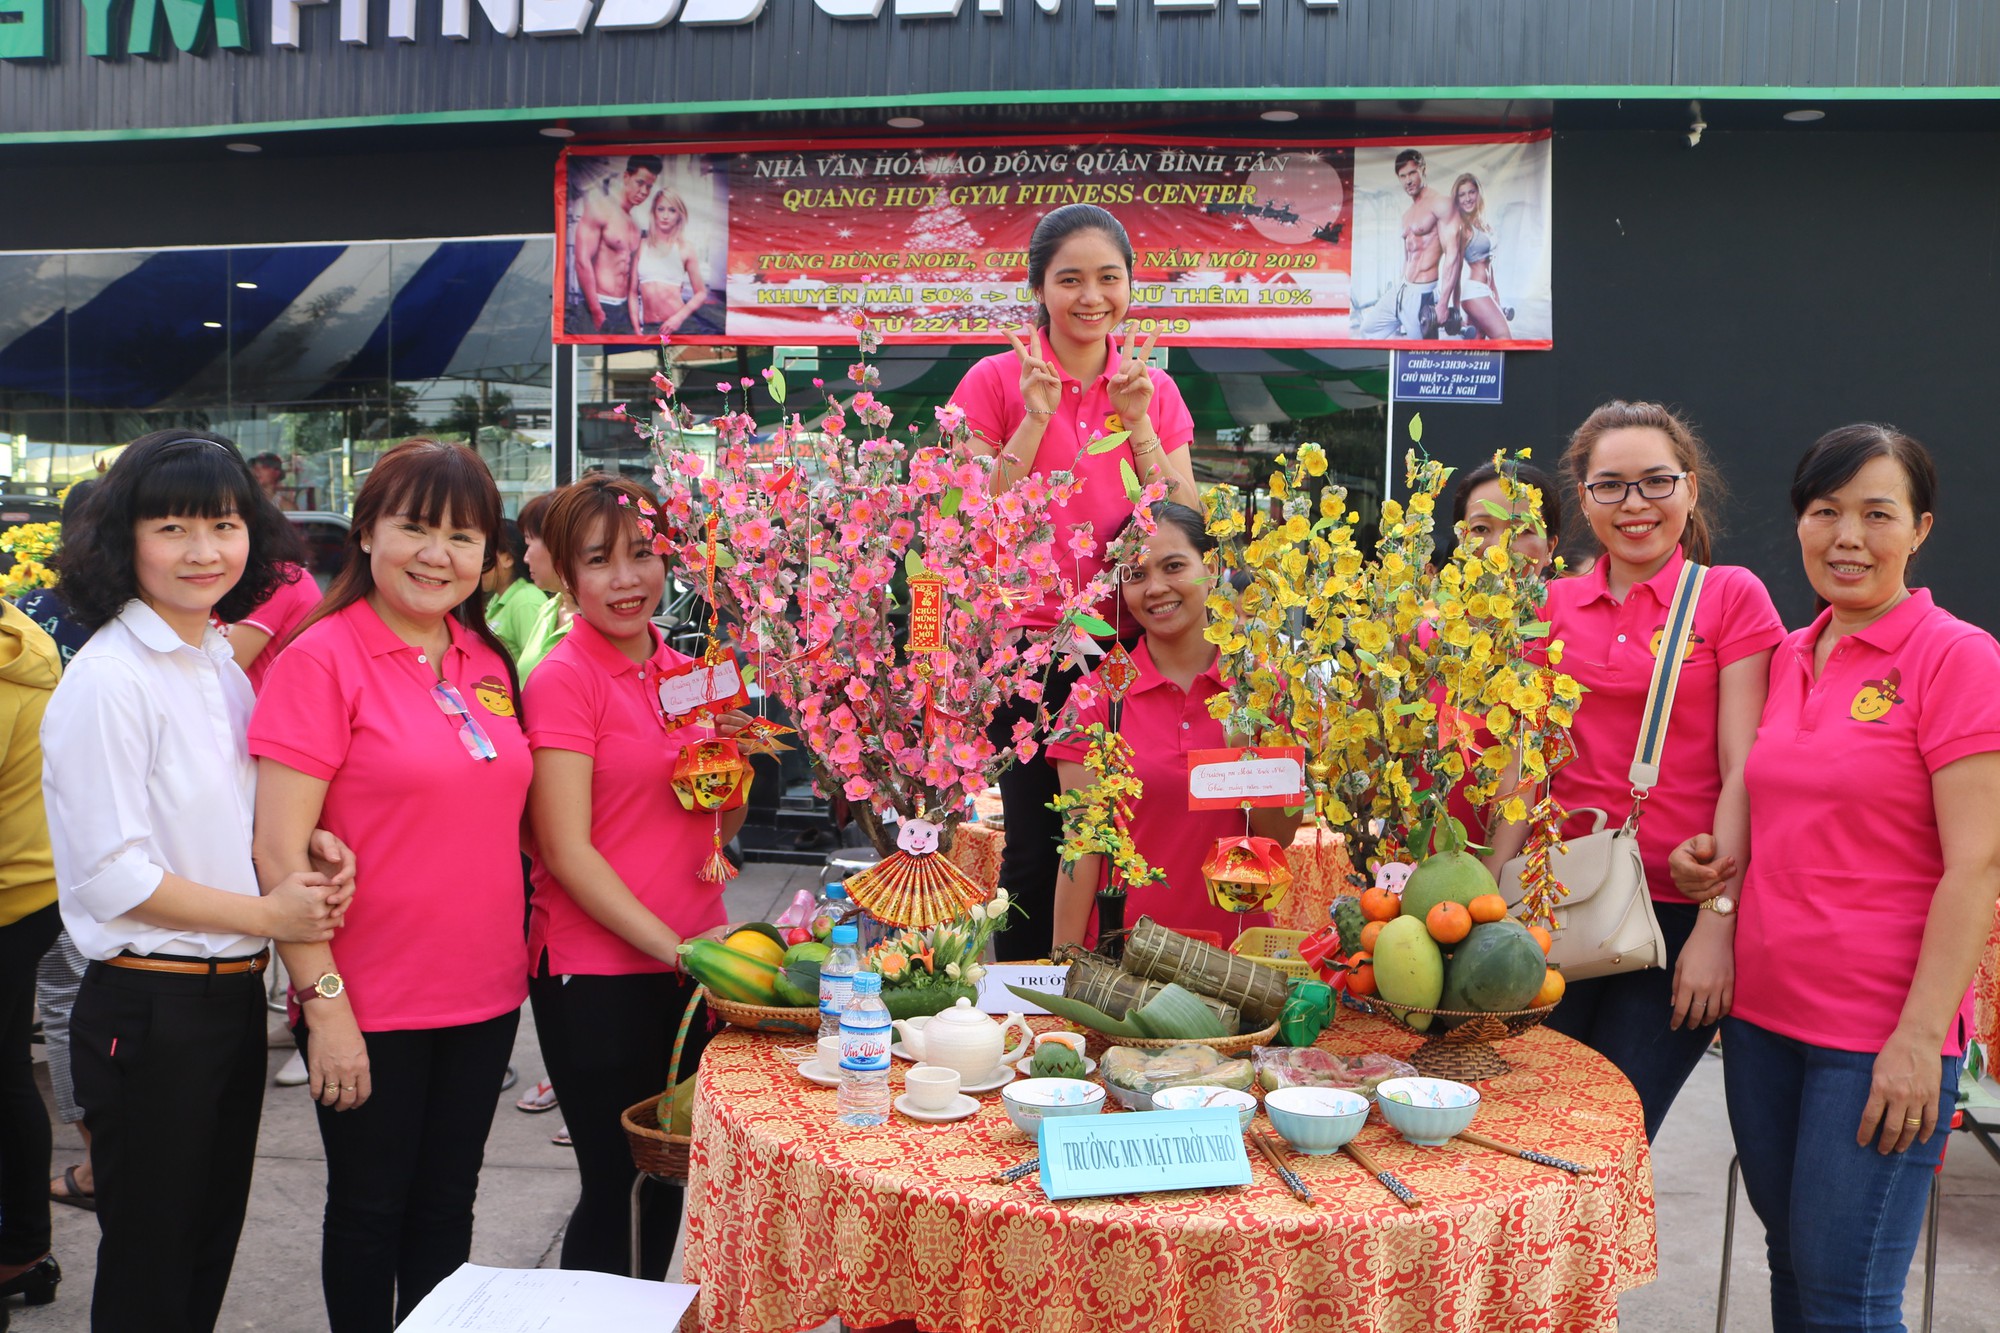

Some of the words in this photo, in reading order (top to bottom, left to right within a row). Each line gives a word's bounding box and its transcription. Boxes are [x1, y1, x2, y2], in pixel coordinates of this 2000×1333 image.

[754, 154, 808, 178] NHÀ
[816, 152, 868, 177] VĂN
[873, 152, 928, 176] HÓA
[935, 155, 986, 175] LAO
[992, 150, 1068, 177] ĐỘNG
[1076, 148, 1152, 176] QUẬN
[1157, 150, 1227, 172] BÌNH
[1234, 151, 1290, 172] TÂN
[782, 187, 877, 212] QUANG
[883, 186, 944, 206] HUY
[950, 185, 1010, 206] GYM
[1015, 183, 1135, 205] FITNESS
[1142, 184, 1257, 205] CENTER
[758, 251, 825, 270] TƯNG
[830, 250, 899, 269] BỪNG
[904, 252, 977, 270] NOEL,
[1143, 248, 1203, 268] NĂM
[1207, 248, 1260, 268] MỚI
[1263, 253, 1317, 269] 2019
[757, 283, 858, 304] KHUYẾN
[865, 285, 913, 303] MÃI
[921, 287, 973, 302] 50%
[1171, 285, 1249, 304] THÊM
[1259, 289, 1312, 305] 10%
[869, 315, 905, 333] TỪ
[1063, 1131, 1120, 1171] TRƯỜNG
[1120, 1140, 1145, 1168] MN
[1144, 1133, 1174, 1173] MẶT
[1173, 1127, 1207, 1164] TRỜI
[1207, 1125, 1236, 1162] NHỎ
